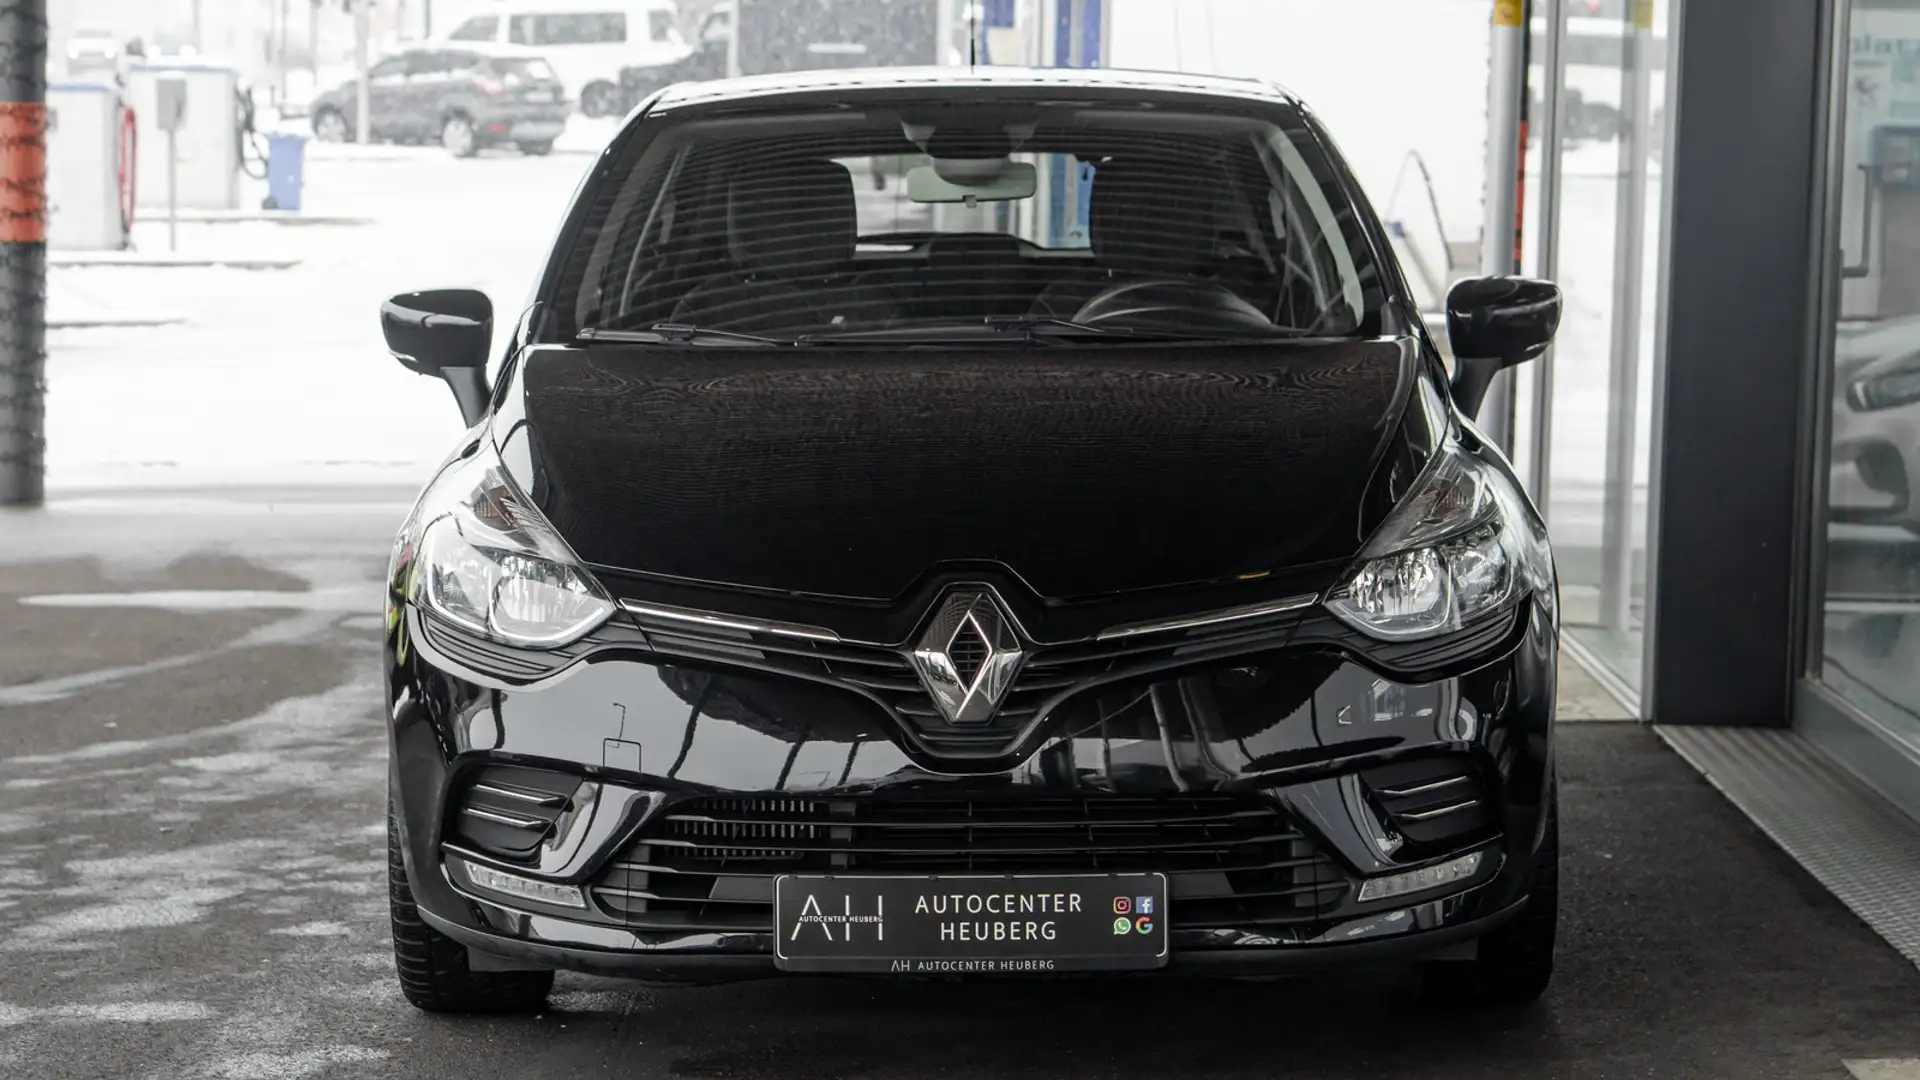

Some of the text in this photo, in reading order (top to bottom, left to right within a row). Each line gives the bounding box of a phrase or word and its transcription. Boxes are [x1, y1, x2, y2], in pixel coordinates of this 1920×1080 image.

[914, 893, 1082, 914] AUTOCENTER
[790, 894, 883, 941] AH
[799, 915, 884, 923] AUTOCENTER HEUBERG
[940, 921, 1056, 941] HEUBERG
[891, 959, 1055, 972] AH AUTOCENTER HEUBERG
